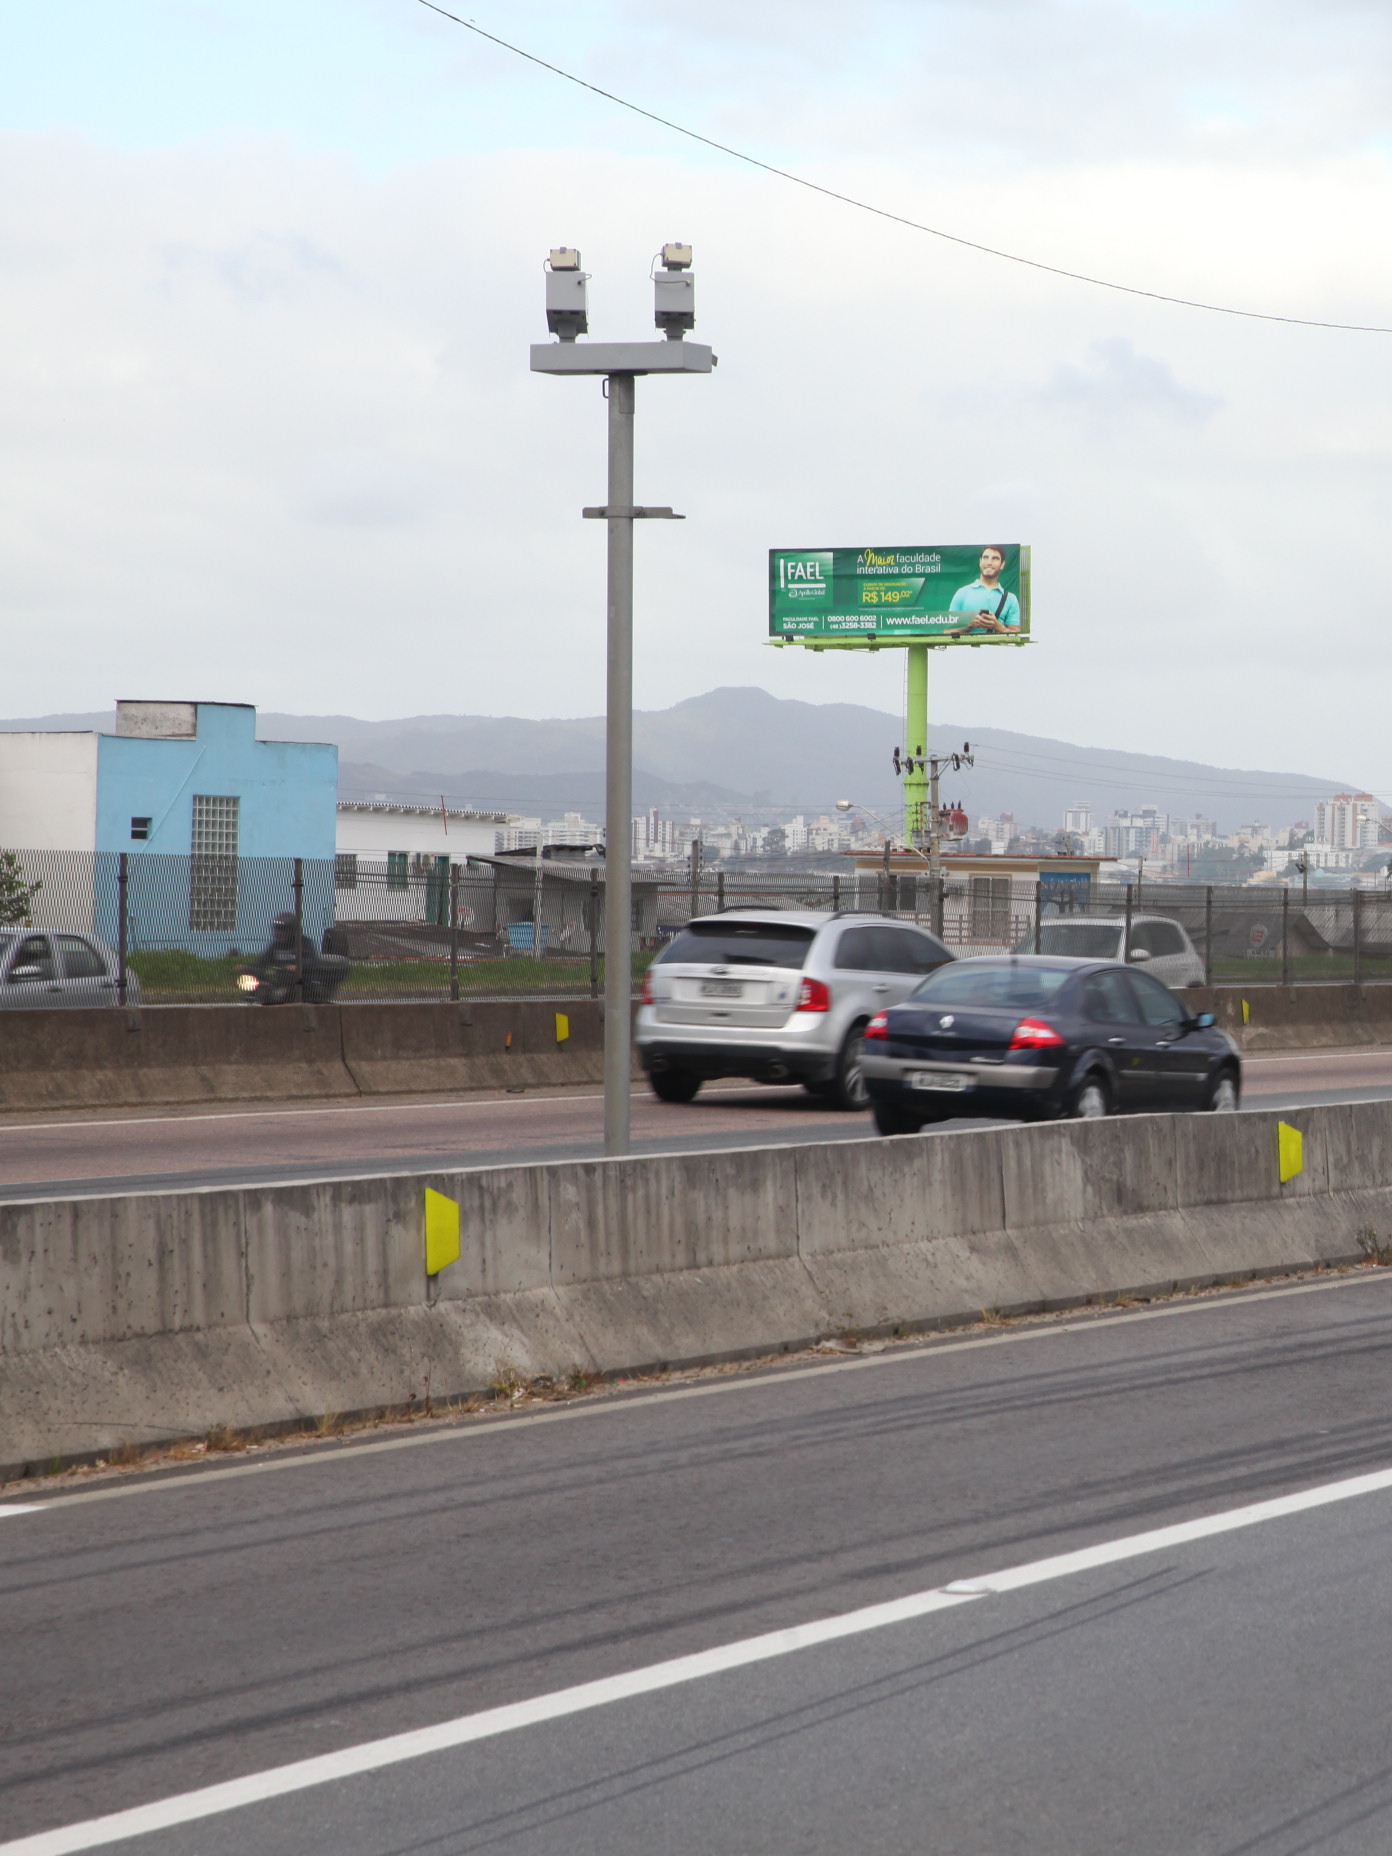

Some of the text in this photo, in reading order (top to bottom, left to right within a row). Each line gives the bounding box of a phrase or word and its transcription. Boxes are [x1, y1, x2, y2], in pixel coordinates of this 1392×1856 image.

[857, 554, 864, 563] A
[896, 553, 941, 563] faculdade
[787, 562, 824, 580] FAEL
[856, 563, 941, 575] interativa do Brasil
[862, 591, 878, 604] R$
[886, 614, 959, 625] www.fael.edu.br
